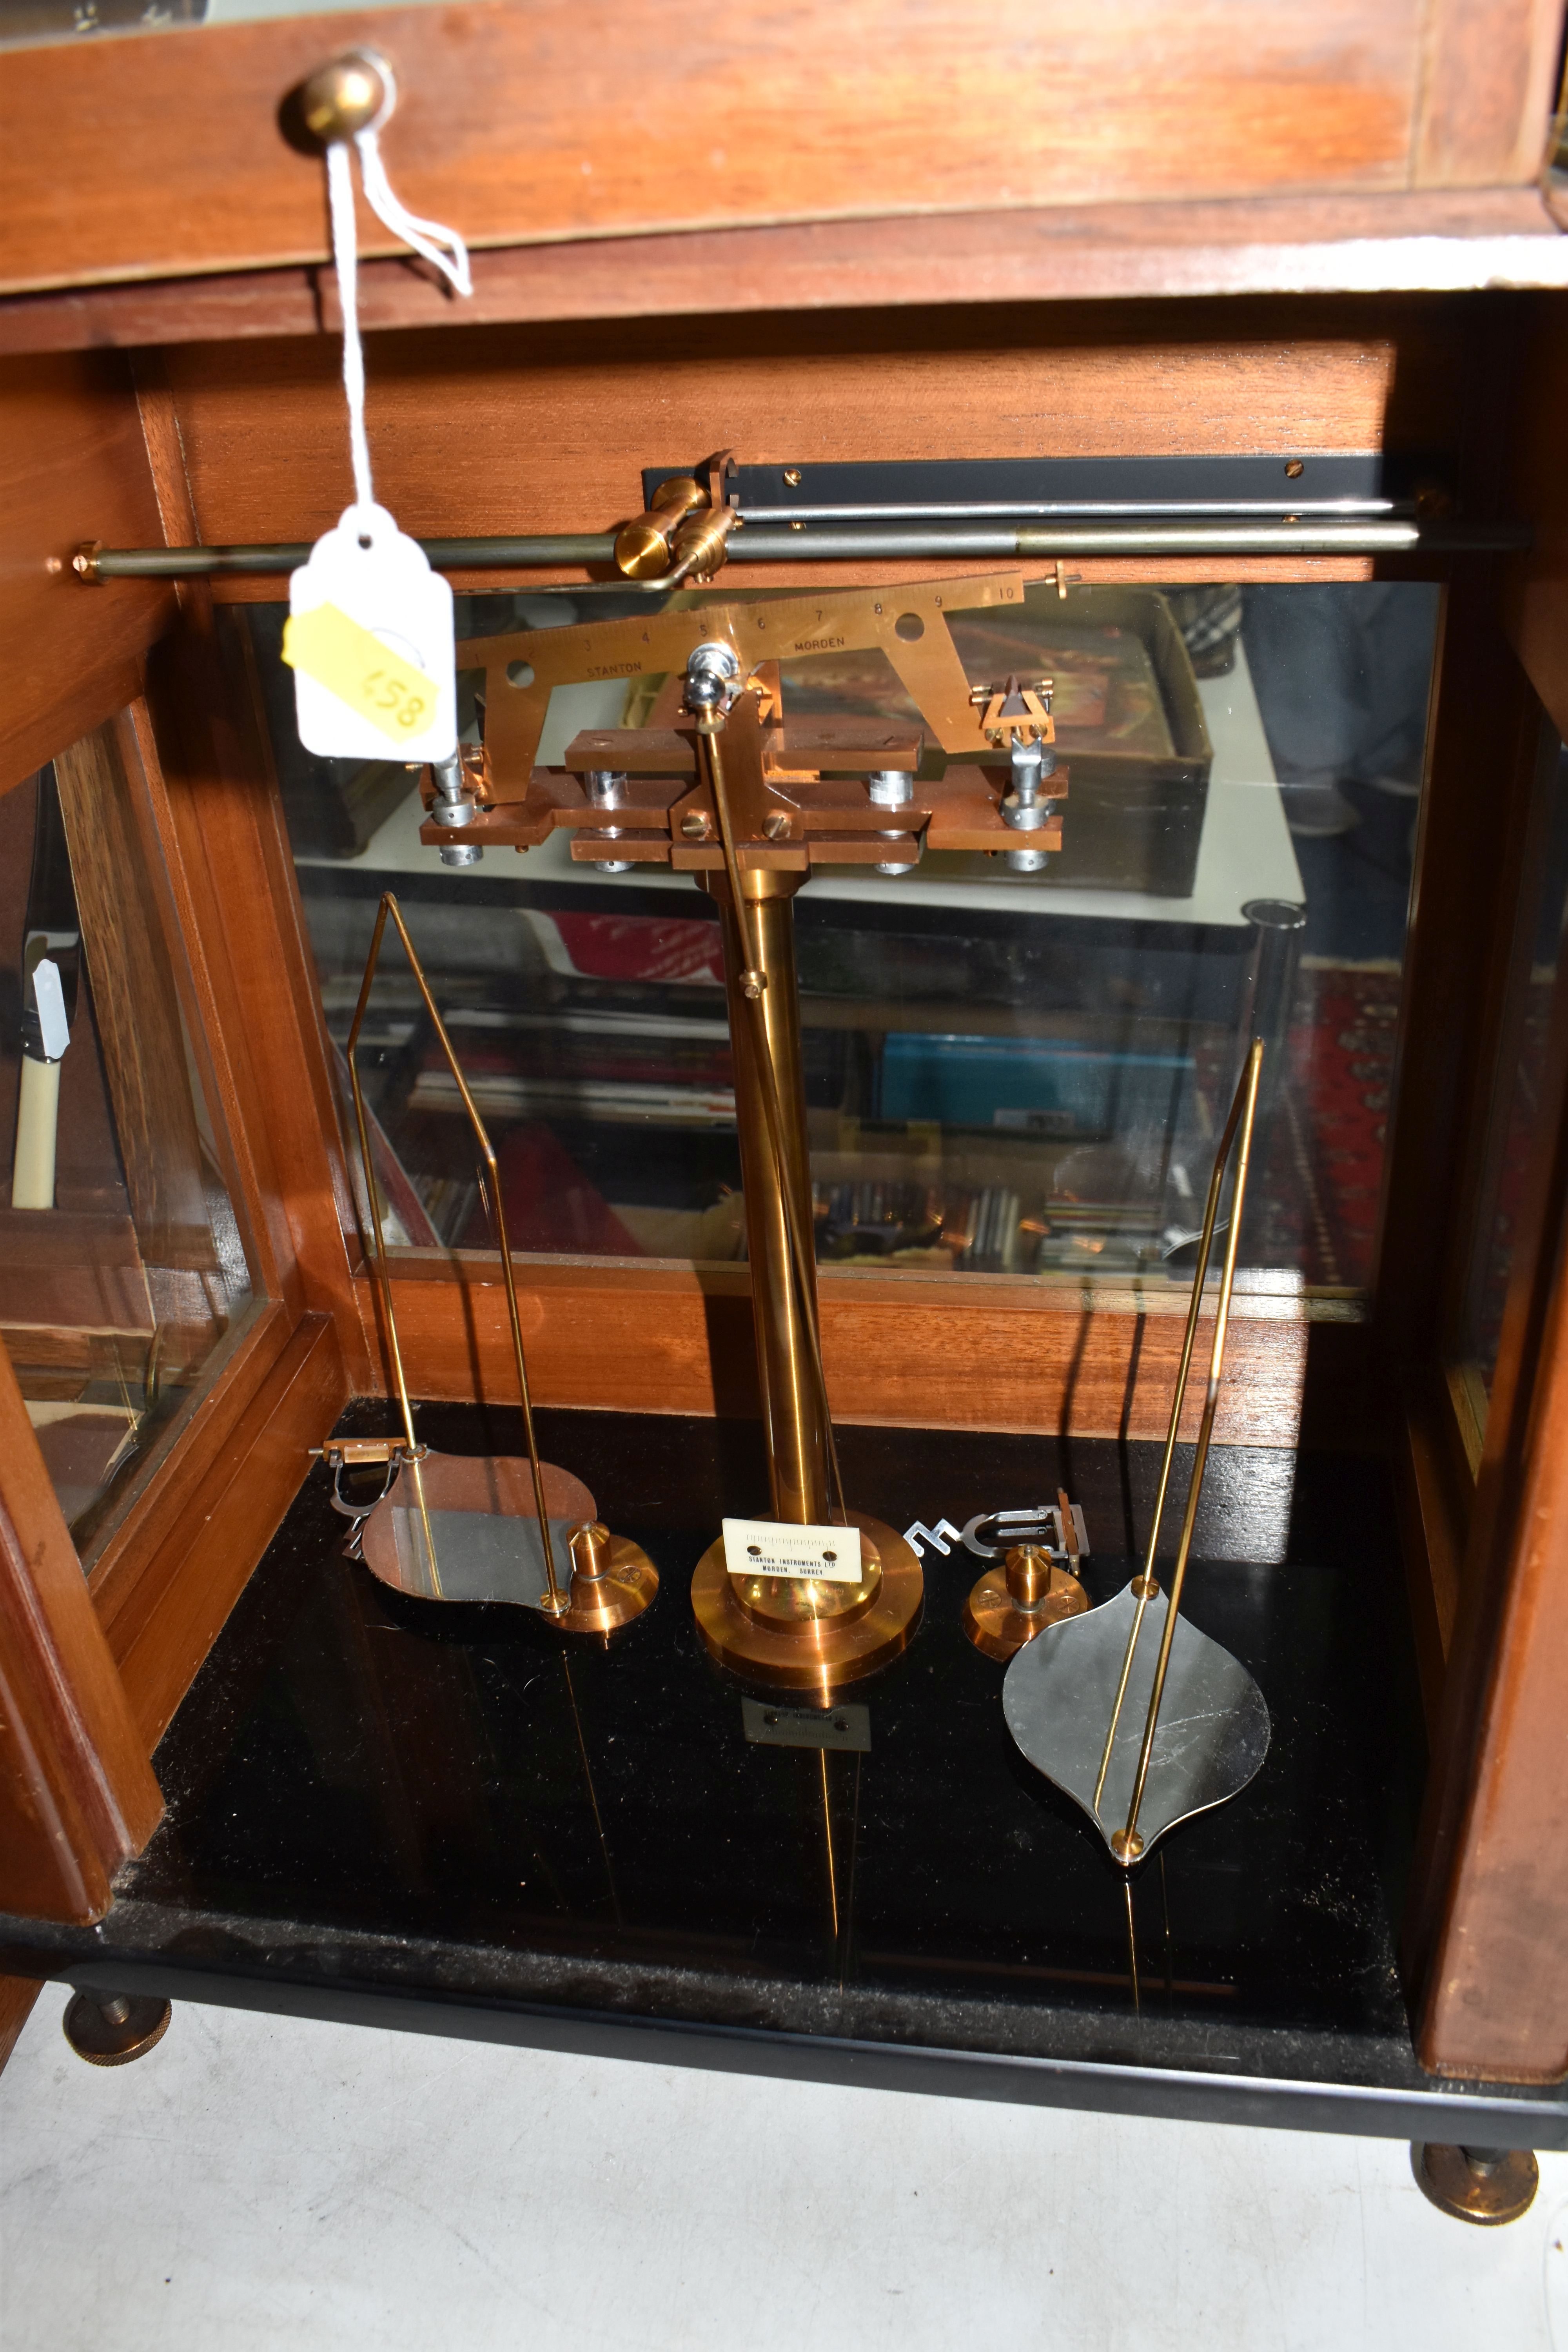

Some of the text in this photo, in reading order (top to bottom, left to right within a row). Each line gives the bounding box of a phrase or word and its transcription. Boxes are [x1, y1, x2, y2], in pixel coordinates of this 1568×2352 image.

[529, 647, 539, 659] 2
[583, 639, 592, 652] 3
[642, 632, 650, 644] 4
[699, 625, 707, 637] 5
[757, 618, 766, 630] 6
[815, 610, 823, 622] 7
[874, 603, 882, 615] 8
[935, 595, 942, 607] 9
[999, 587, 1014, 600] 10
[586, 637, 845, 677] STANTON MORDEN
[749, 1556, 775, 1564] STANTON
[779, 1559, 821, 1568] INSTRUMENTS
